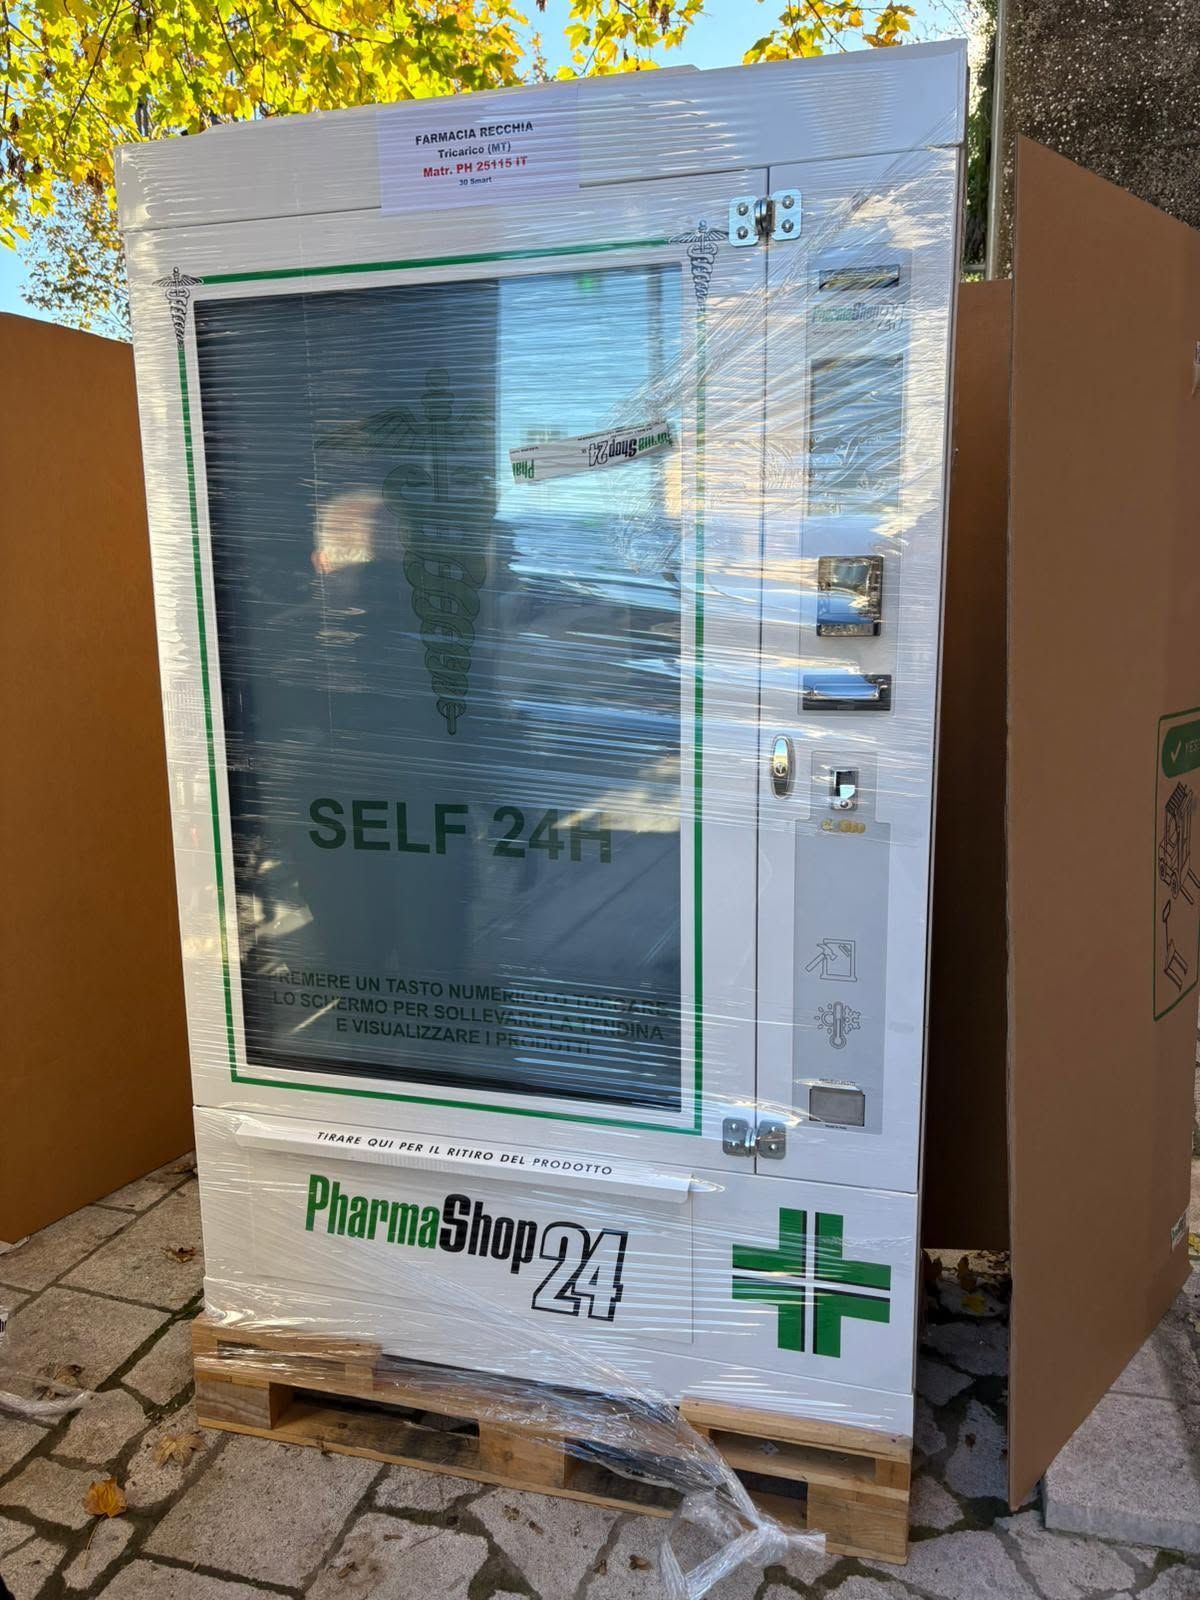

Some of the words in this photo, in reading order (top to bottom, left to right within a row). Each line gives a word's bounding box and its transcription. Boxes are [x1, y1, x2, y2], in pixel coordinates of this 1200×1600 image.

[415, 128, 476, 146] FARMACIA
[480, 121, 534, 137] RECCHIA
[438, 145, 485, 159] Tricarico
[487, 141, 512, 155] (MT)
[423, 166, 453, 178] Matr.
[456, 162, 473, 174] PH
[476, 158, 512, 172] 25115
[515, 156, 528, 167] IT
[459, 178, 468, 186] 30
[470, 176, 492, 185] Smart
[308, 797, 469, 855] SELF
[492, 805, 612, 864] 24H
[356, 975, 380, 992] UN
[386, 978, 443, 997] TASTO
[273, 991, 296, 1006] LO
[300, 992, 387, 1014] SCHERMO
[393, 1000, 428, 1018] PER
[434, 1004, 545, 1029] SOLLEVARE
[550, 1014, 574, 1032] LA
[577, 1016, 665, 1041] TENDINA
[336, 1017, 348, 1032] E
[352, 1018, 480, 1045] VISUALIZZARE
[485, 1031, 491, 1046] I
[317, 1131, 362, 1145] TIRARE
[367, 1137, 394, 1150] QUI
[399, 1141, 423, 1153] PER
[428, 1144, 441, 1155] IL
[446, 1147, 494, 1161] RITIRO
[500, 1154, 526, 1166] DEL
[531, 1157, 613, 1176] PRODOTTO
[305, 1173, 629, 1322] PharmaShop24
